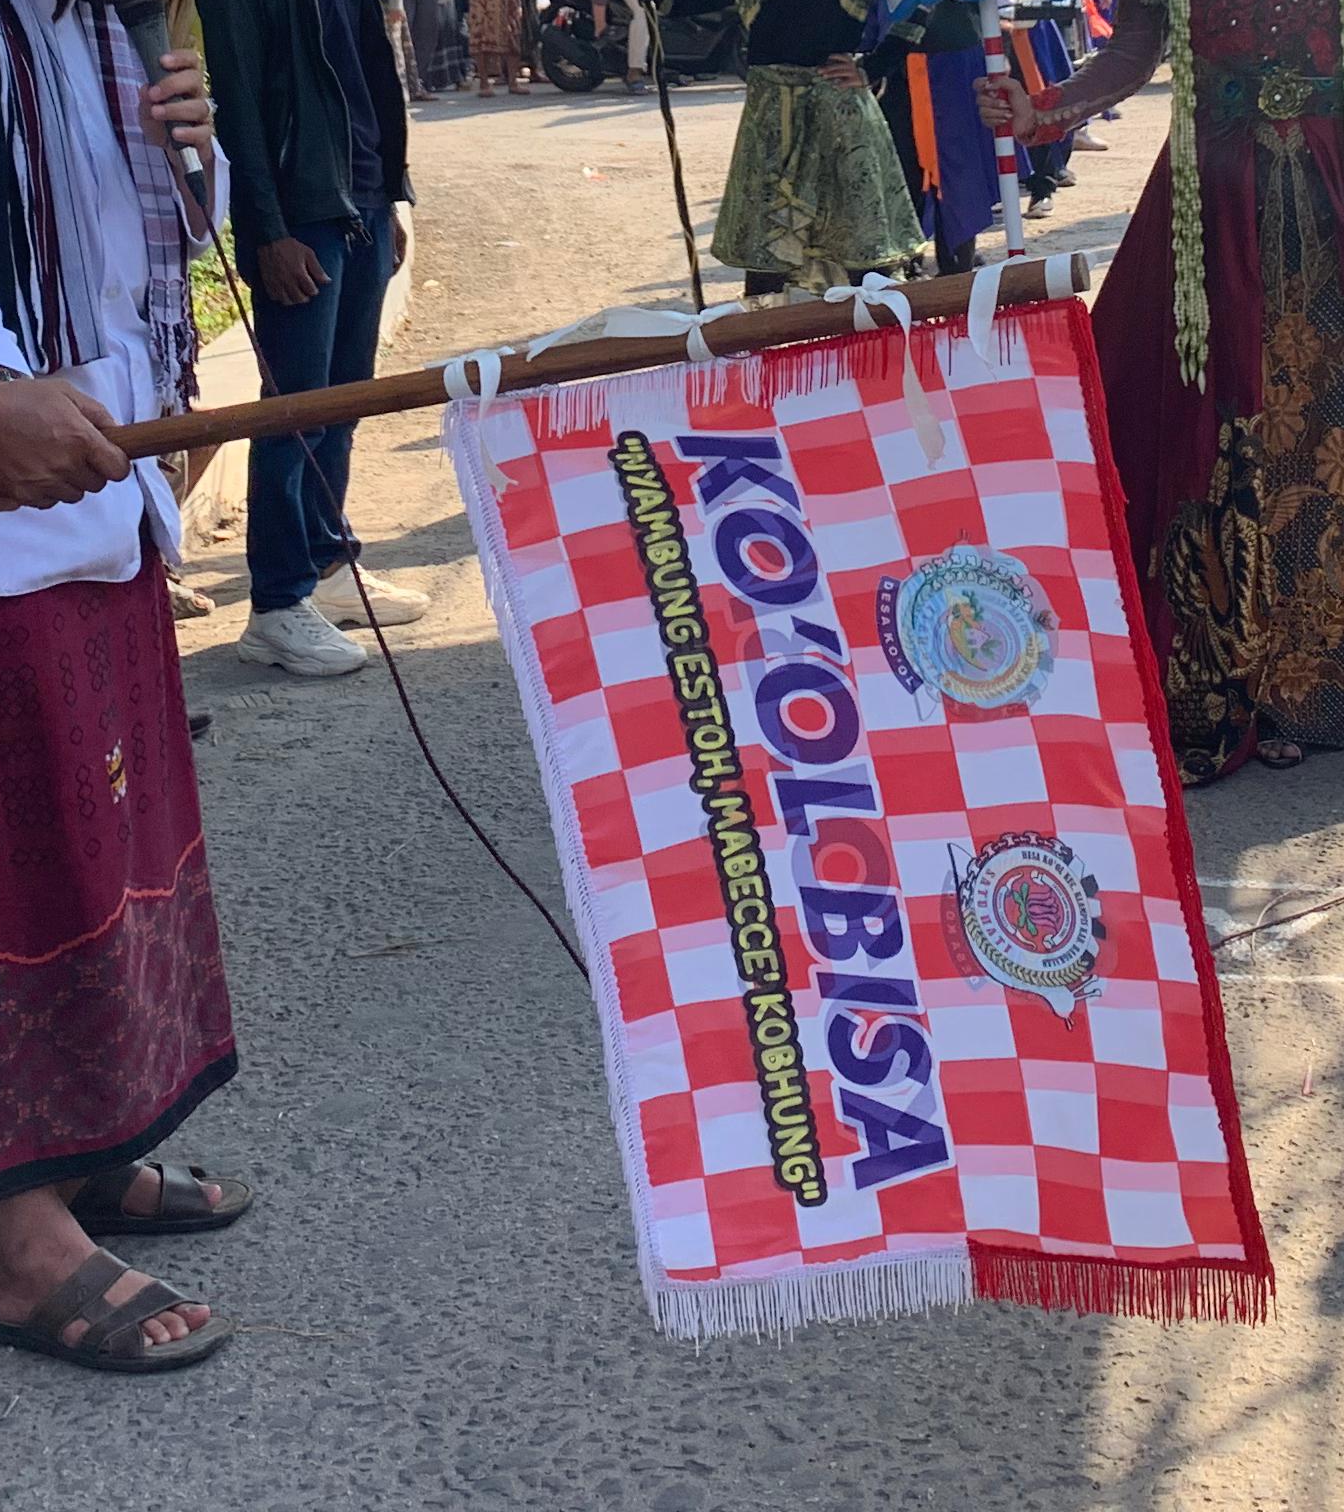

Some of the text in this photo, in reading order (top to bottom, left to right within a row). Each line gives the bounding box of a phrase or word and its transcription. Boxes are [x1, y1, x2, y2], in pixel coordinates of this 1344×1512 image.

[879, 580, 895, 626] DESA
[672, 652, 736, 789] ESTOH,
[674, 435, 951, 1191] KO'OL BISA
